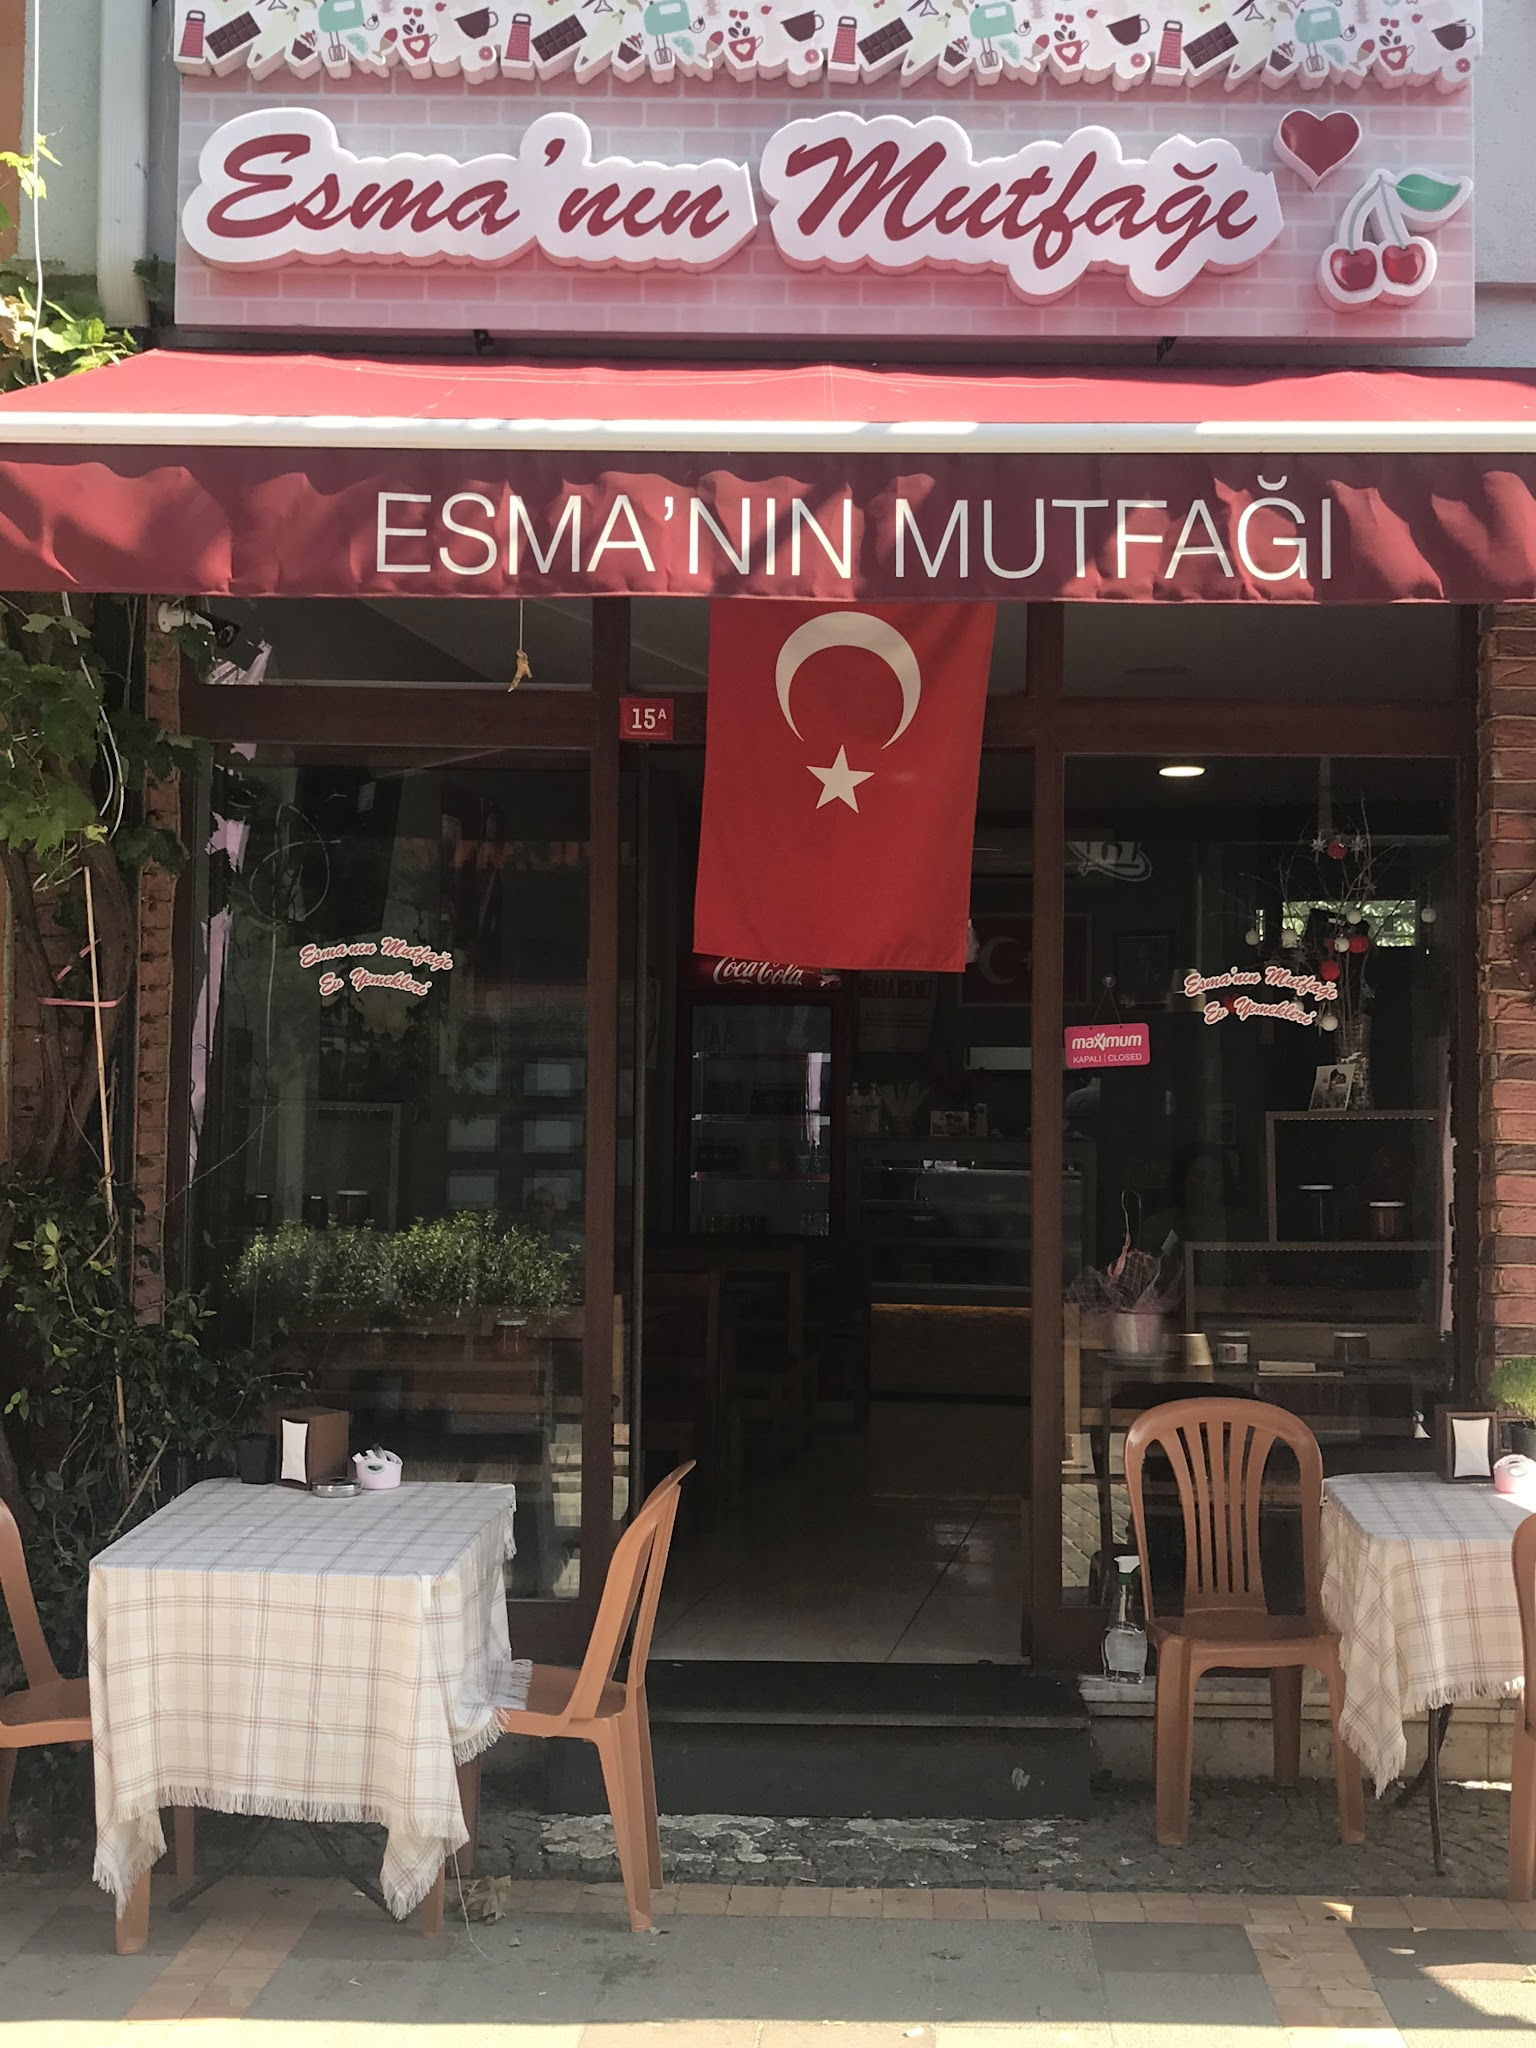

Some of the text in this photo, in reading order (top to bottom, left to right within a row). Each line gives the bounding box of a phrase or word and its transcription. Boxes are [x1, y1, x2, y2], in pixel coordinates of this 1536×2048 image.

[206, 134, 1257, 271] Esma'nın Mutfağı
[376, 475, 1333, 580] ESMA'NIN MUTFAĞI
[381, 936, 453, 972] Mutfağı
[319, 967, 432, 996] Ev Yemekleri
[1264, 965, 1338, 1001] Mutfağı
[1204, 996, 1317, 1026] Ev Yemekleri
[1073, 1052, 1142, 1064] KAPALI CLOSED
